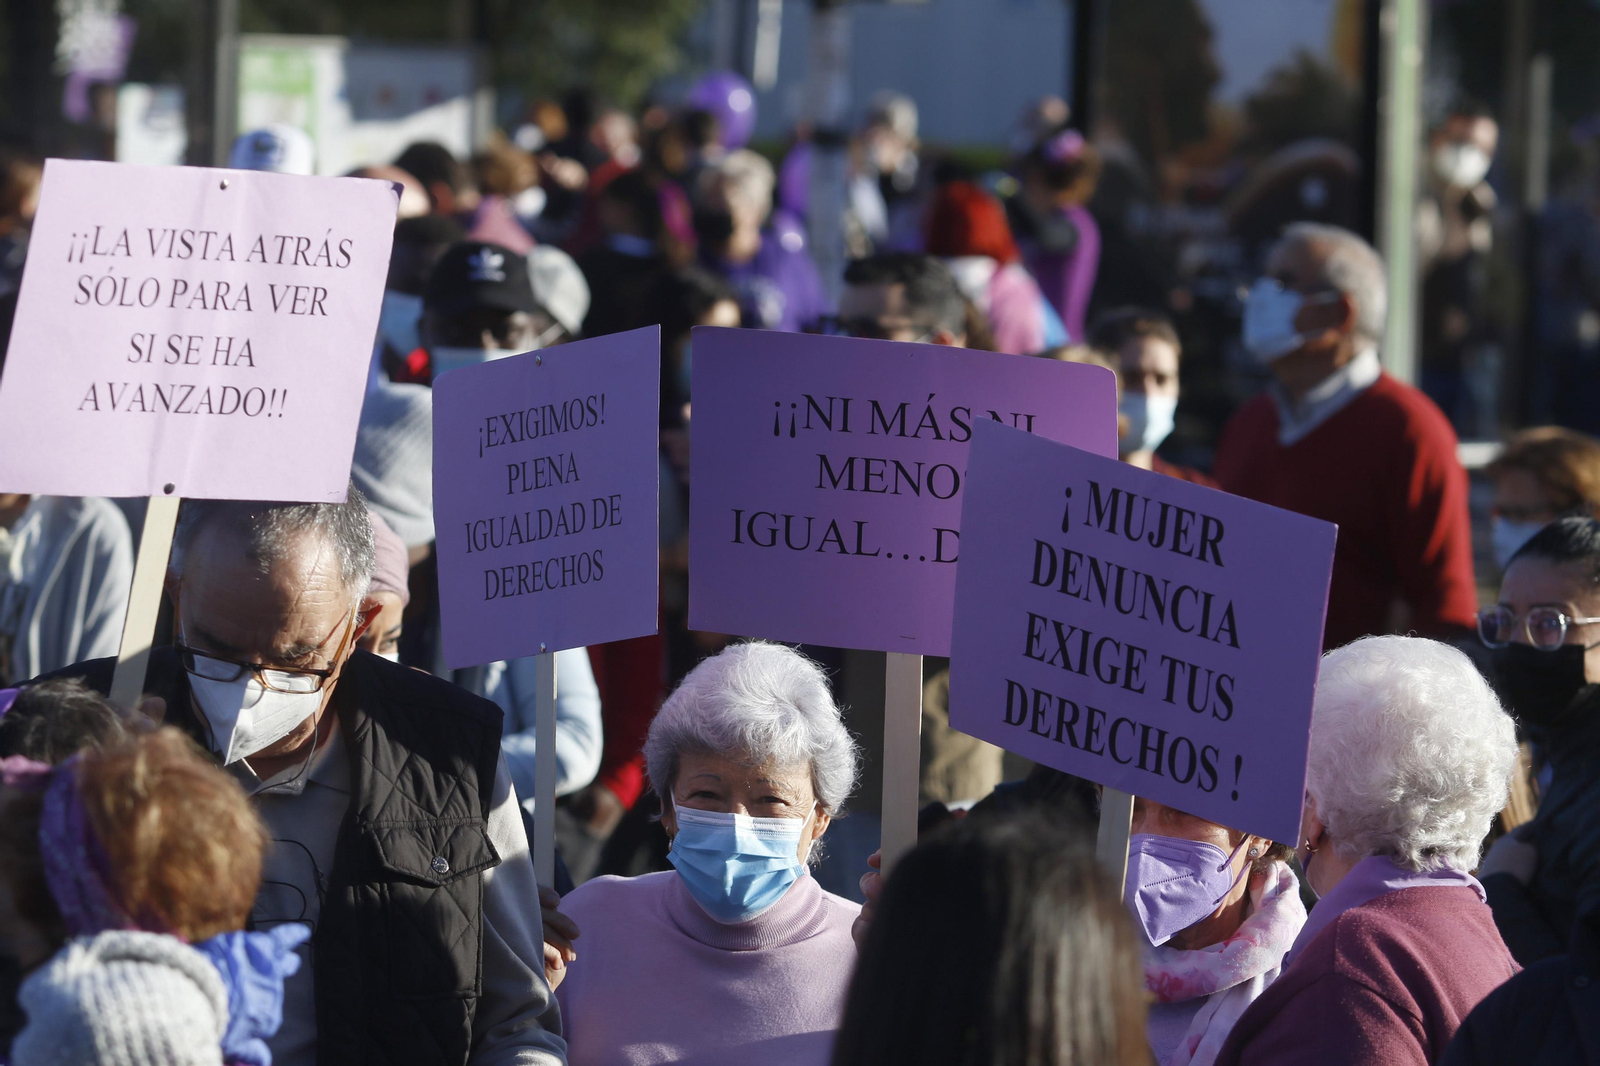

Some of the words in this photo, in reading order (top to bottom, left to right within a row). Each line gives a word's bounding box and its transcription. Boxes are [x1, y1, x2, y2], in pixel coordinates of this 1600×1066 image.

[67, 225, 131, 264] ¡¡LA
[147, 227, 236, 262] VISTA
[246, 228, 354, 270] ATRÁS
[74, 266, 160, 308] SÓLO
[169, 278, 254, 313] PARA
[268, 283, 329, 317] VER
[126, 333, 155, 364] SI
[163, 334, 204, 366] SE
[211, 336, 256, 368] HA
[77, 381, 288, 419] AVANZADO!!
[773, 393, 855, 440] ¡¡NI
[866, 392, 972, 444] MÁS
[478, 393, 606, 459] ¡EXIGIMOS!
[506, 451, 581, 496] PLENA
[813, 453, 968, 501] MENO
[464, 501, 587, 554] IGUALDAD
[591, 493, 623, 531] DE
[483, 549, 605, 602] DERECHOS
[1029, 538, 1242, 650] DENUNCIA
[1021, 610, 1148, 696] EXIGE
[1159, 653, 1236, 723] TUS
